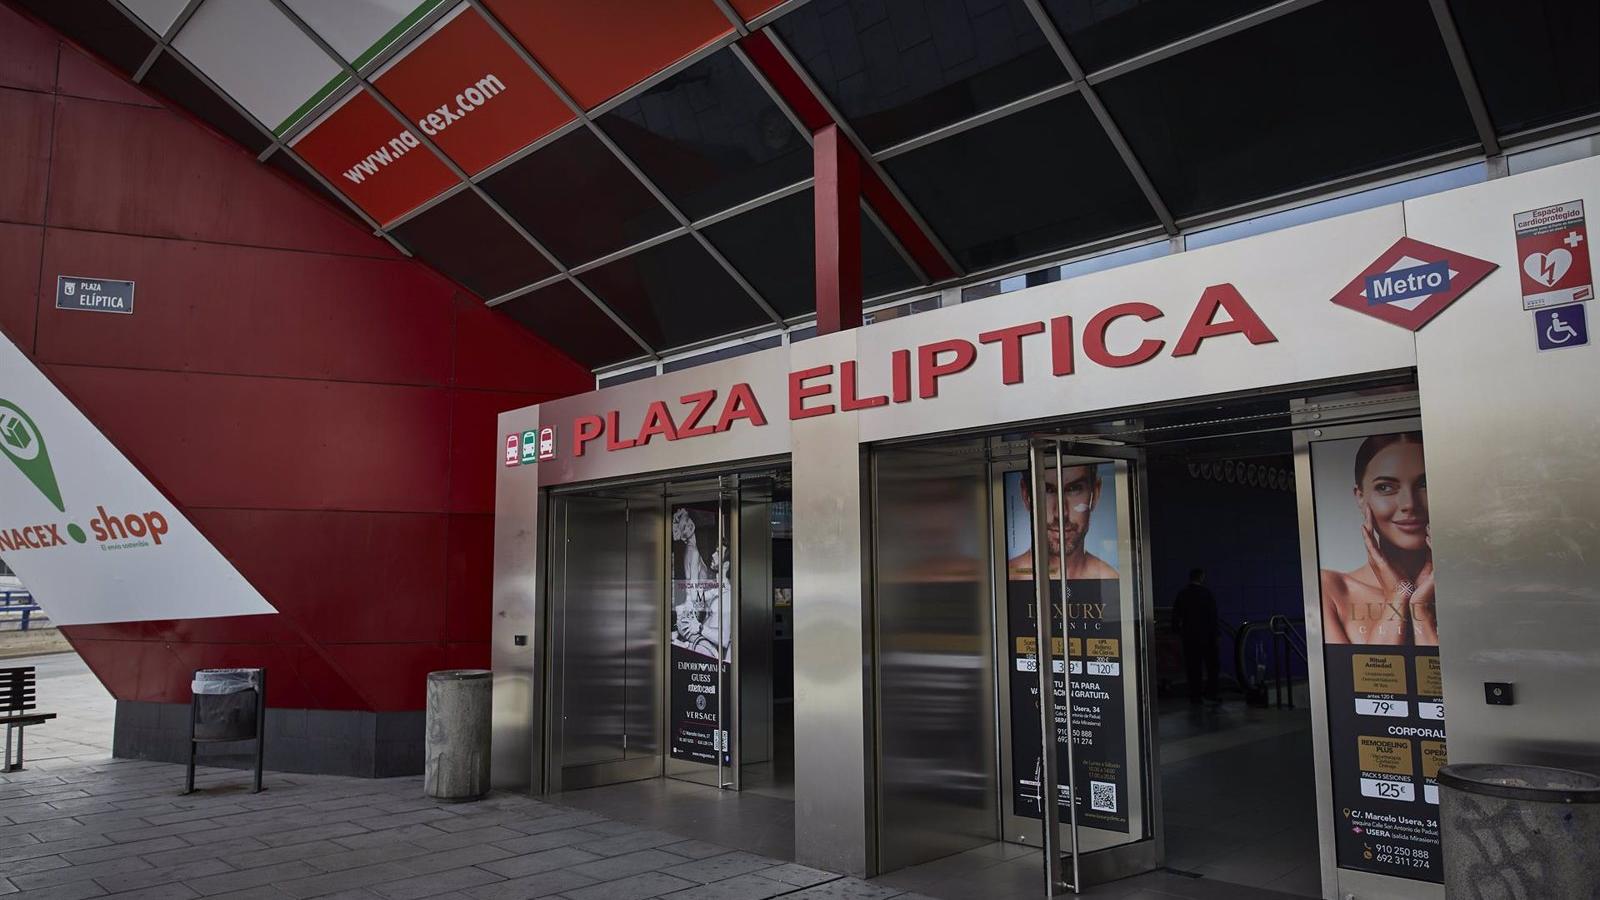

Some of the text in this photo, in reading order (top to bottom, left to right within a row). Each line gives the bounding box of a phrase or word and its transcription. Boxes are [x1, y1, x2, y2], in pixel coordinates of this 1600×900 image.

[1532, 206, 1564, 218] Espacio
[1517, 210, 1581, 228] cardioprotegido
[80, 282, 102, 292] PLAZA
[1373, 271, 1442, 299] Metro
[79, 292, 124, 308] ELÍPTICA
[572, 282, 1279, 457] PLAZA ELIPTICA
[0, 505, 169, 551] NACEX shop
[1027, 602, 1107, 619] LXURY
[691, 673, 711, 682] GUESS
[1080, 682, 1101, 691] PARA
[1074, 690, 1111, 700] GRATUITA
[1372, 701, 1395, 714] 79€
[686, 710, 717, 721] VERSACE
[1387, 725, 1446, 738] CORPORAL
[1361, 739, 1408, 750] REMODELING
[1361, 771, 1378, 779] PACK
[1381, 773, 1411, 783] SESIONES
[1425, 777, 1438, 785] PAC
[1375, 782, 1406, 798] 125€
[1364, 812, 1397, 823] Marcelo
[1397, 816, 1425, 827] Usera,
[1426, 820, 1438, 828] 34
[1366, 829, 1391, 838] USERA
[1375, 843, 1429, 859] 910 250 888
[1376, 853, 1430, 869] 692 311 274
